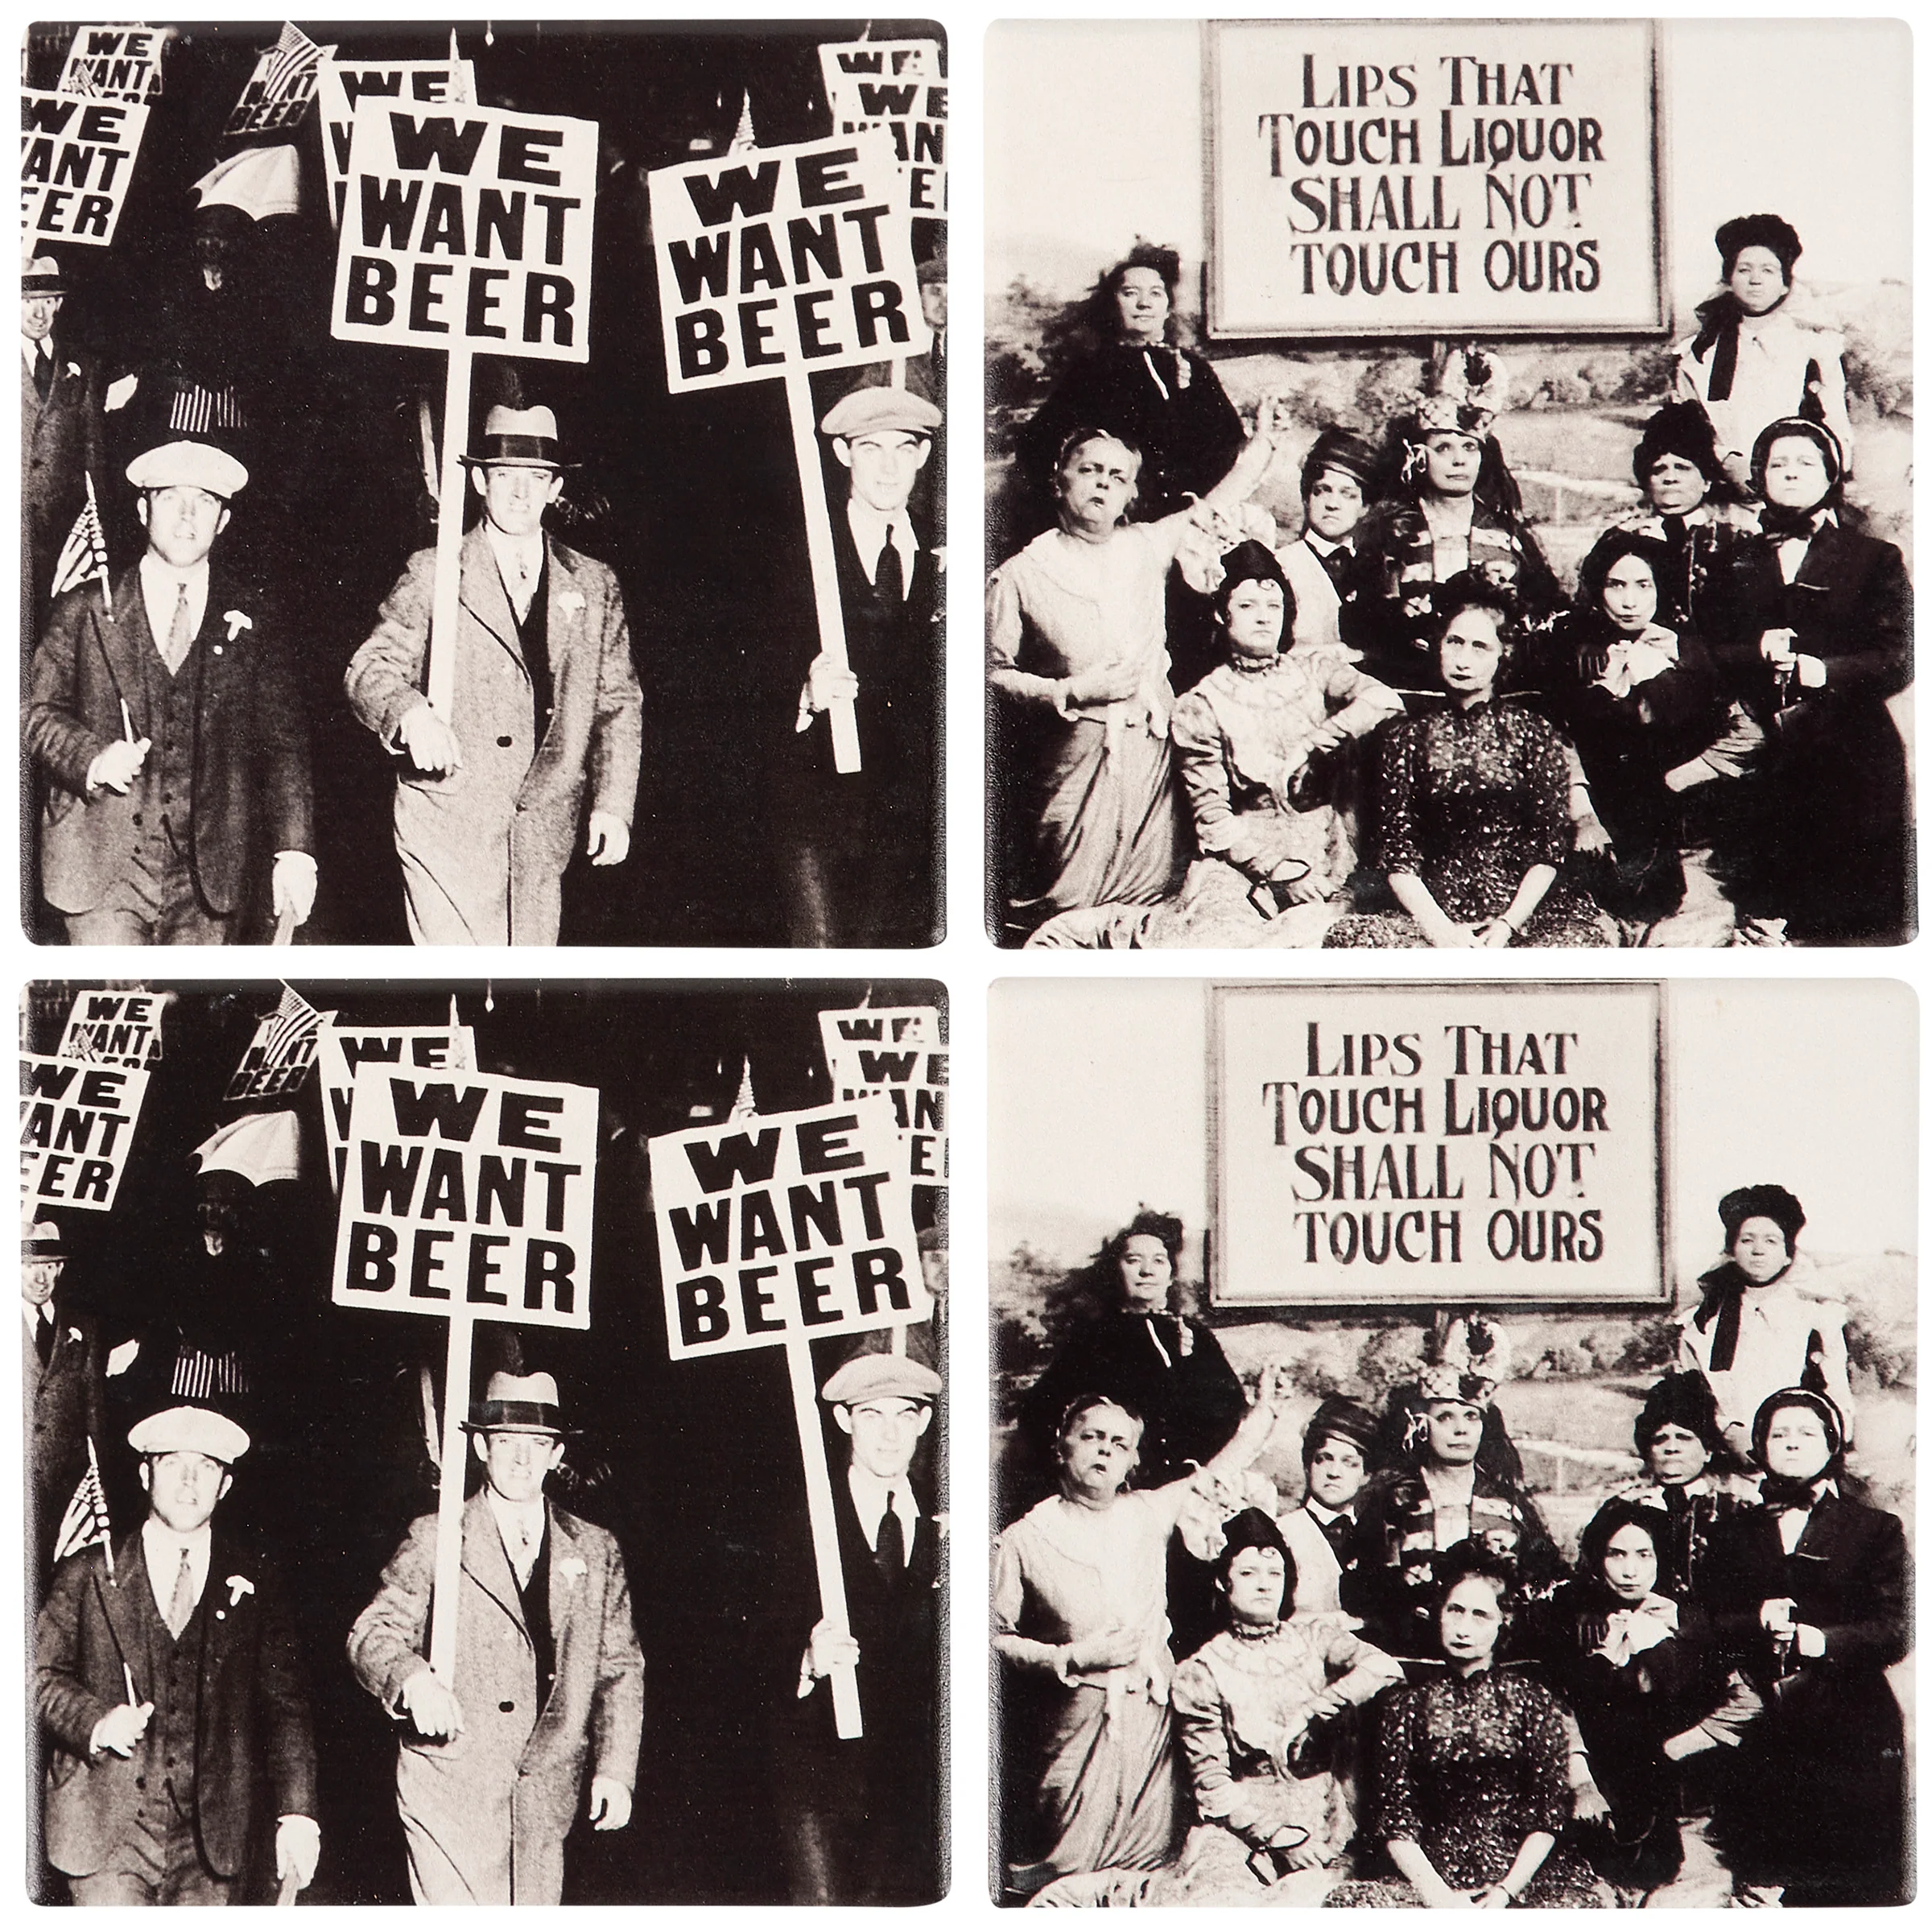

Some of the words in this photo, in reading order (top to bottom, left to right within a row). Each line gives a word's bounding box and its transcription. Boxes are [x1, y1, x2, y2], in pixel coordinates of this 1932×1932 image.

[86, 32, 153, 57] WE
[21, 95, 127, 143] WE
[339, 71, 450, 113] WE
[21, 136, 130, 192] ANT
[390, 112, 564, 186] WE
[361, 175, 580, 265] WANT
[683, 147, 865, 227] WE
[1288, 175, 1460, 233] SHALL
[1485, 173, 1592, 233] NOT
[668, 204, 890, 304] WANT
[1290, 241, 1459, 295] TOUCH
[1484, 239, 1600, 293] OURS
[345, 256, 575, 347] BEER
[675, 279, 910, 379] BEER
[86, 997, 153, 1022] WE
[19, 1060, 127, 1108] WE
[339, 1037, 450, 1079] WE
[19, 1100, 130, 1157] ANT
[390, 1078, 564, 1153] WE
[361, 1141, 581, 1232] WANT
[683, 1114, 865, 1194] WE
[1292, 1144, 1464, 1202] SHALL
[1489, 1143, 1596, 1204] NOT
[669, 1171, 890, 1271] WANT
[1294, 1211, 1462, 1265] TOUCH
[1487, 1209, 1604, 1262] OURS
[346, 1222, 576, 1313] BEER
[676, 1247, 911, 1346] BEER
